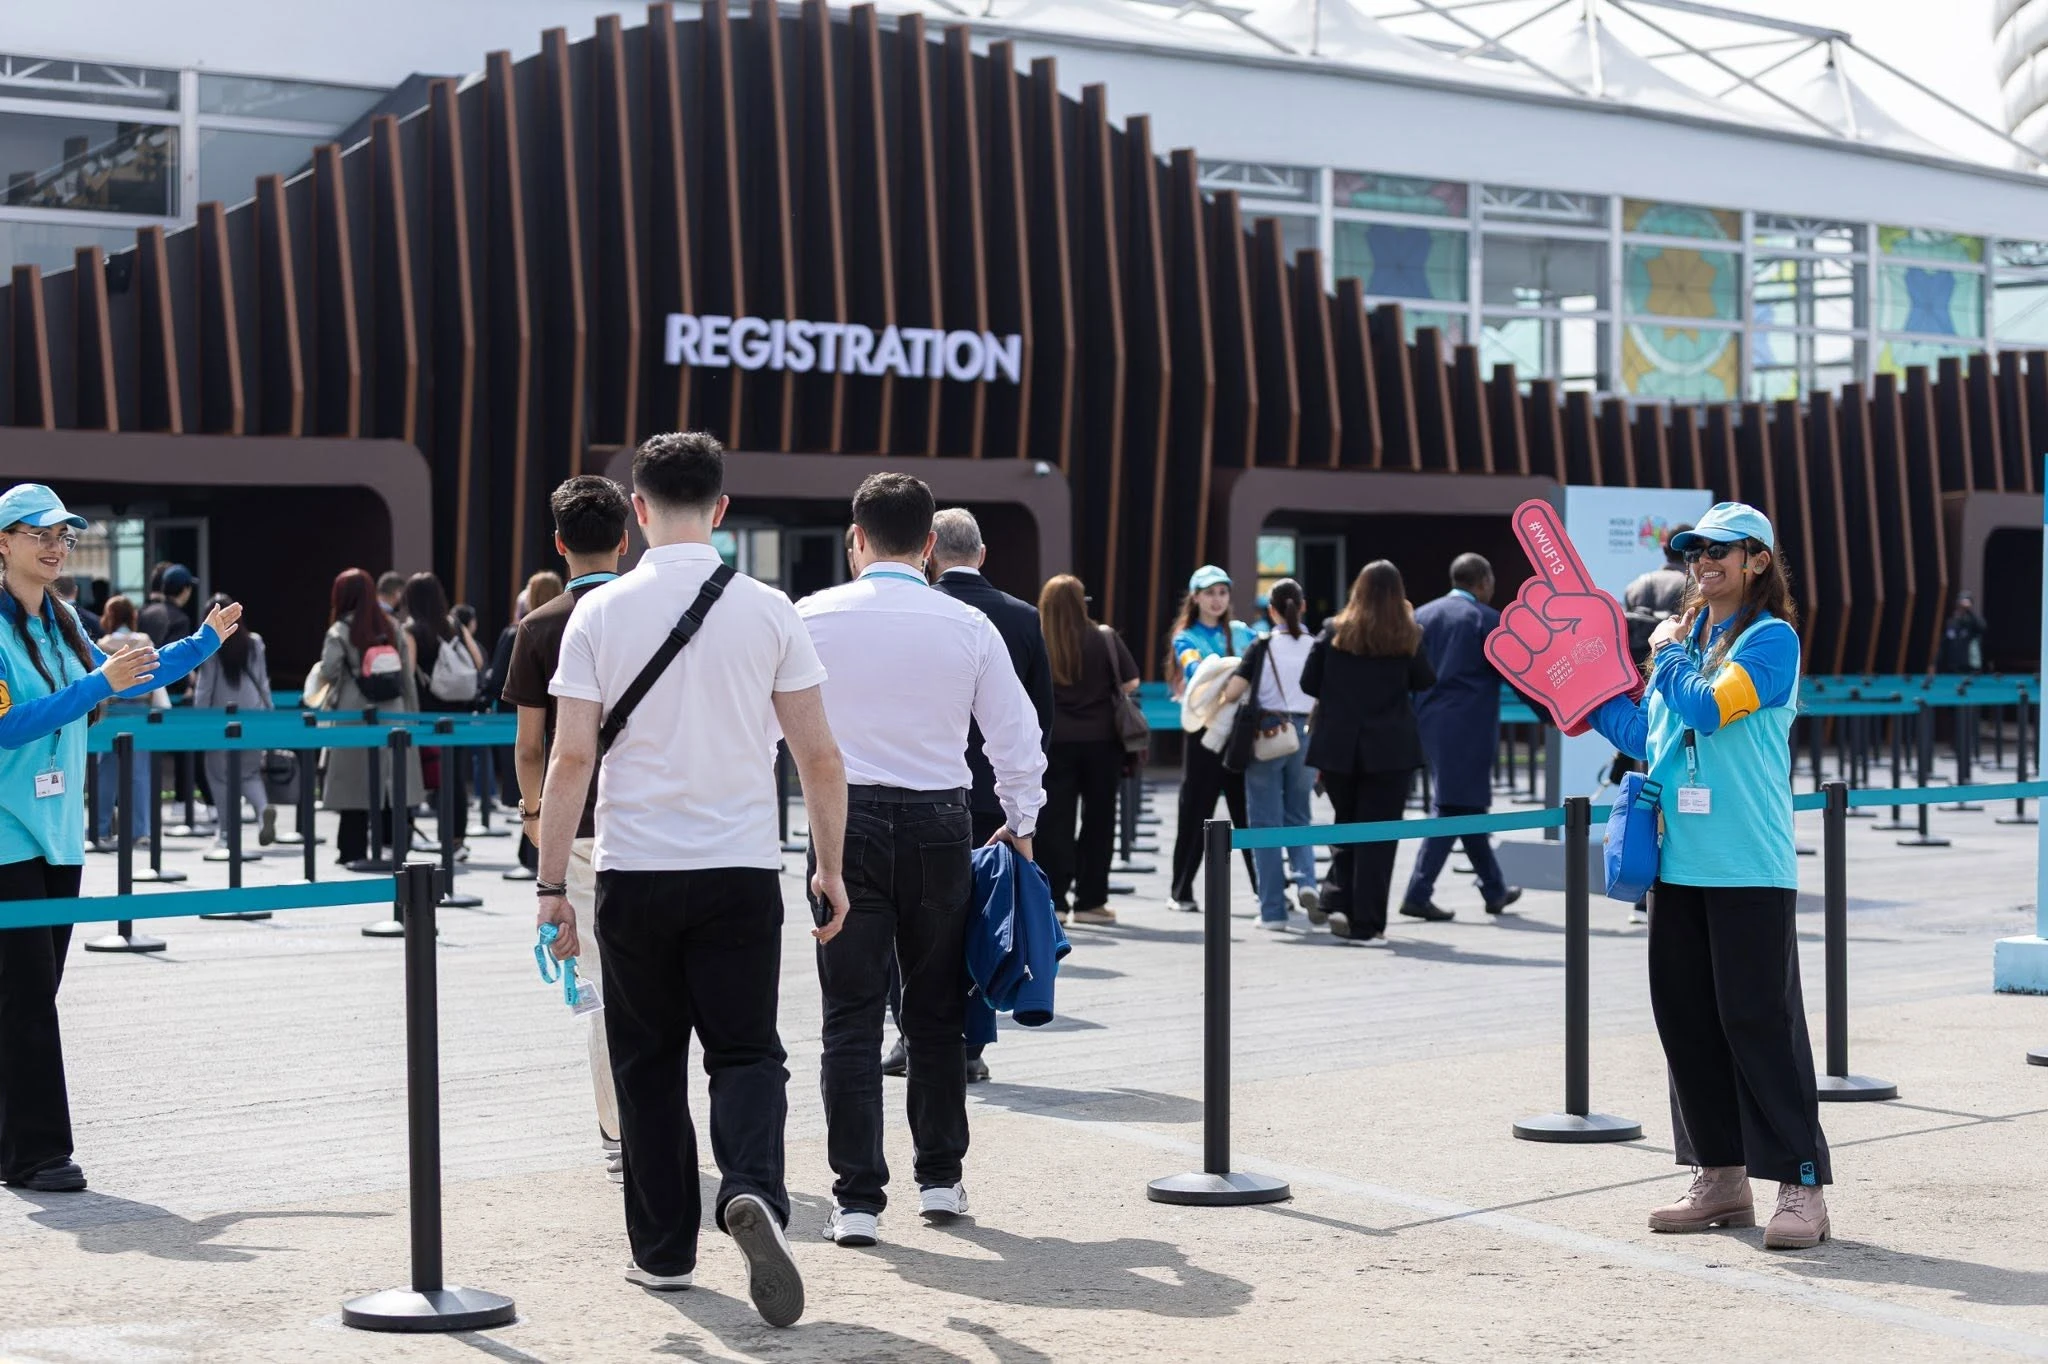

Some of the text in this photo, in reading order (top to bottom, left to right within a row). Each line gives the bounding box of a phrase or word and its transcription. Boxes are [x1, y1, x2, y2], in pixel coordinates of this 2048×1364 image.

[664, 313, 1022, 384] REGISTRATION
[1528, 521, 1565, 575] #WUF13
[1546, 655, 1567, 675] WORLD
[1550, 661, 1571, 681] URBAN
[1552, 667, 1574, 688] FORUM
